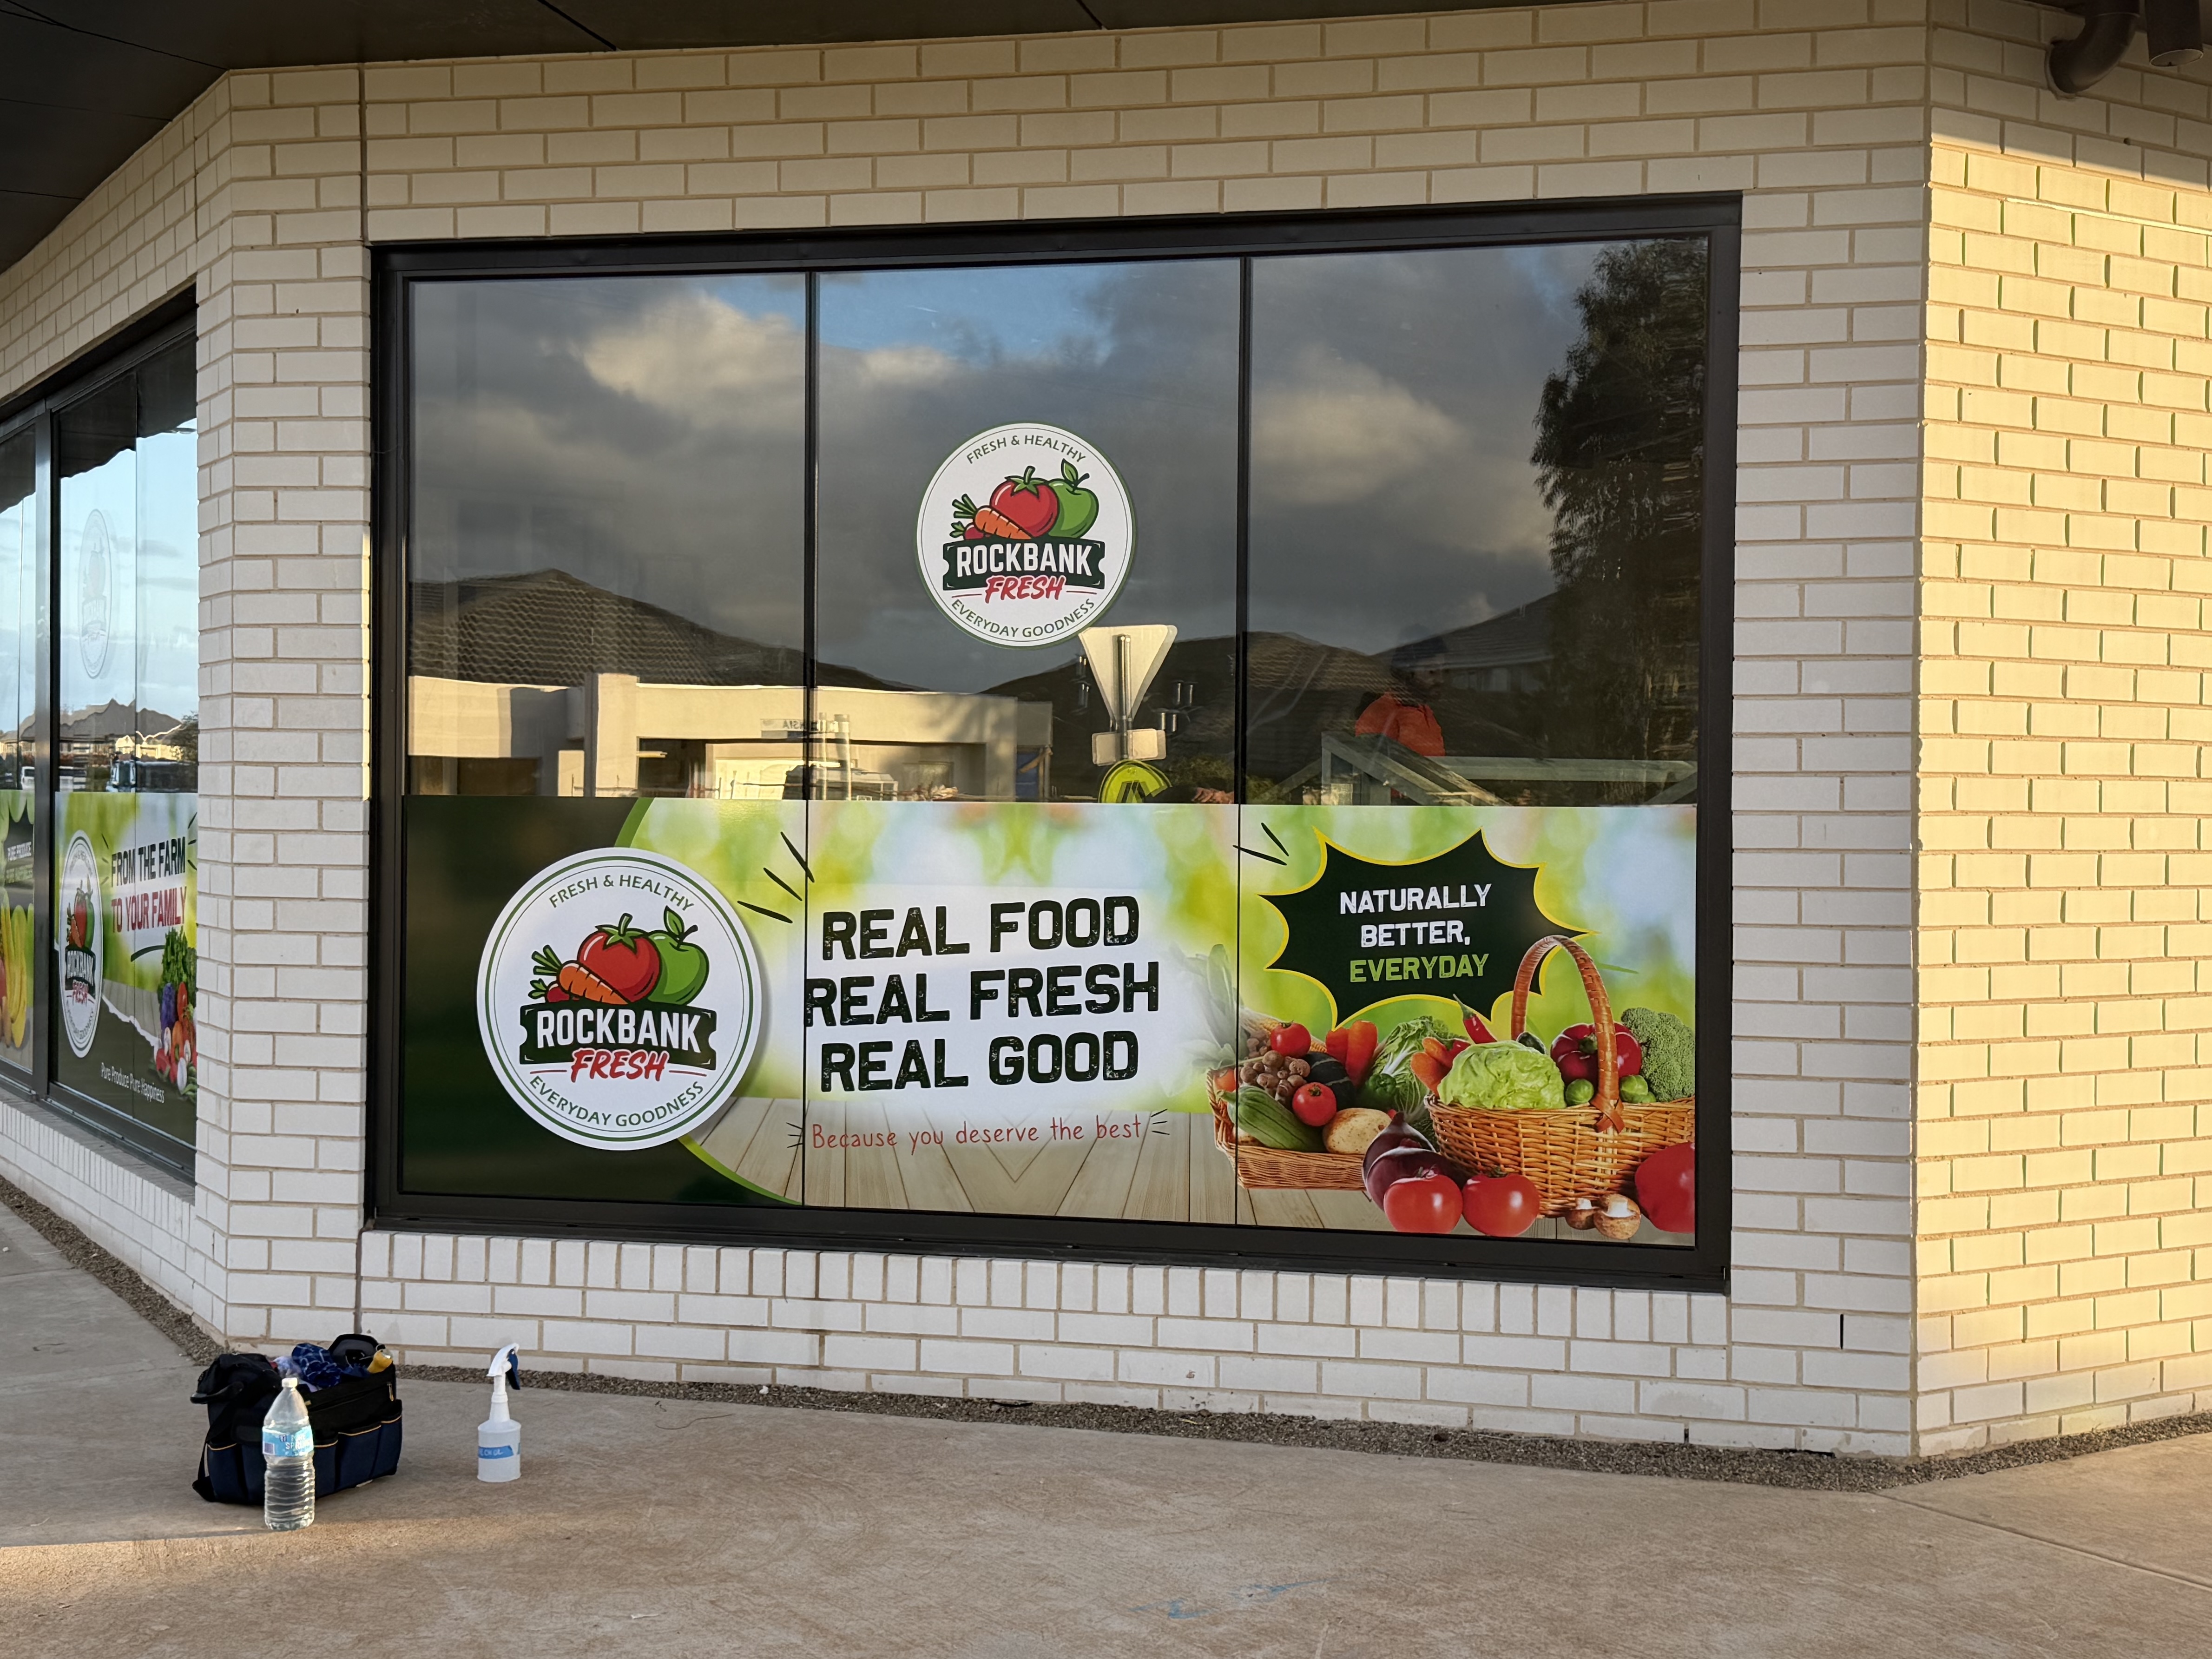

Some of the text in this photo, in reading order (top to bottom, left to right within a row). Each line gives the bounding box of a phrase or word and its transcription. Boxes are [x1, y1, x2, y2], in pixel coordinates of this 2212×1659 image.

[967, 435, 1086, 464] FRESH & HEALTHY
[957, 543, 1093, 577] ROCKBANK
[985, 575, 1065, 604] FRESH
[952, 599, 1095, 637] EVERYDAY GOODNESS
[112, 849, 136, 888] FROM
[138, 844, 156, 882] THE
[159, 836, 185, 878] FARM
[112, 886, 187, 933] TO YOUR FAMILY
[549, 875, 694, 911] FRESH & HEALTHY
[1340, 883, 1492, 914] NATURALLY
[823, 896, 1139, 961] REAL FOOD
[1361, 920, 1470, 948] BETTER,
[1350, 954, 1489, 982] EVERYDAY
[804, 961, 1159, 1027] REAL FRESH
[537, 1009, 701, 1053] ROCKBANK
[571, 1049, 669, 1082] FRESH
[821, 1031, 1139, 1092] REAL GOOD
[101, 1062, 165, 1103] Pure Produce Pure Happiness
[530, 1076, 704, 1126] EVERYDAY GOODNESS
[813, 1114, 1142, 1155] Because you deserve the best
